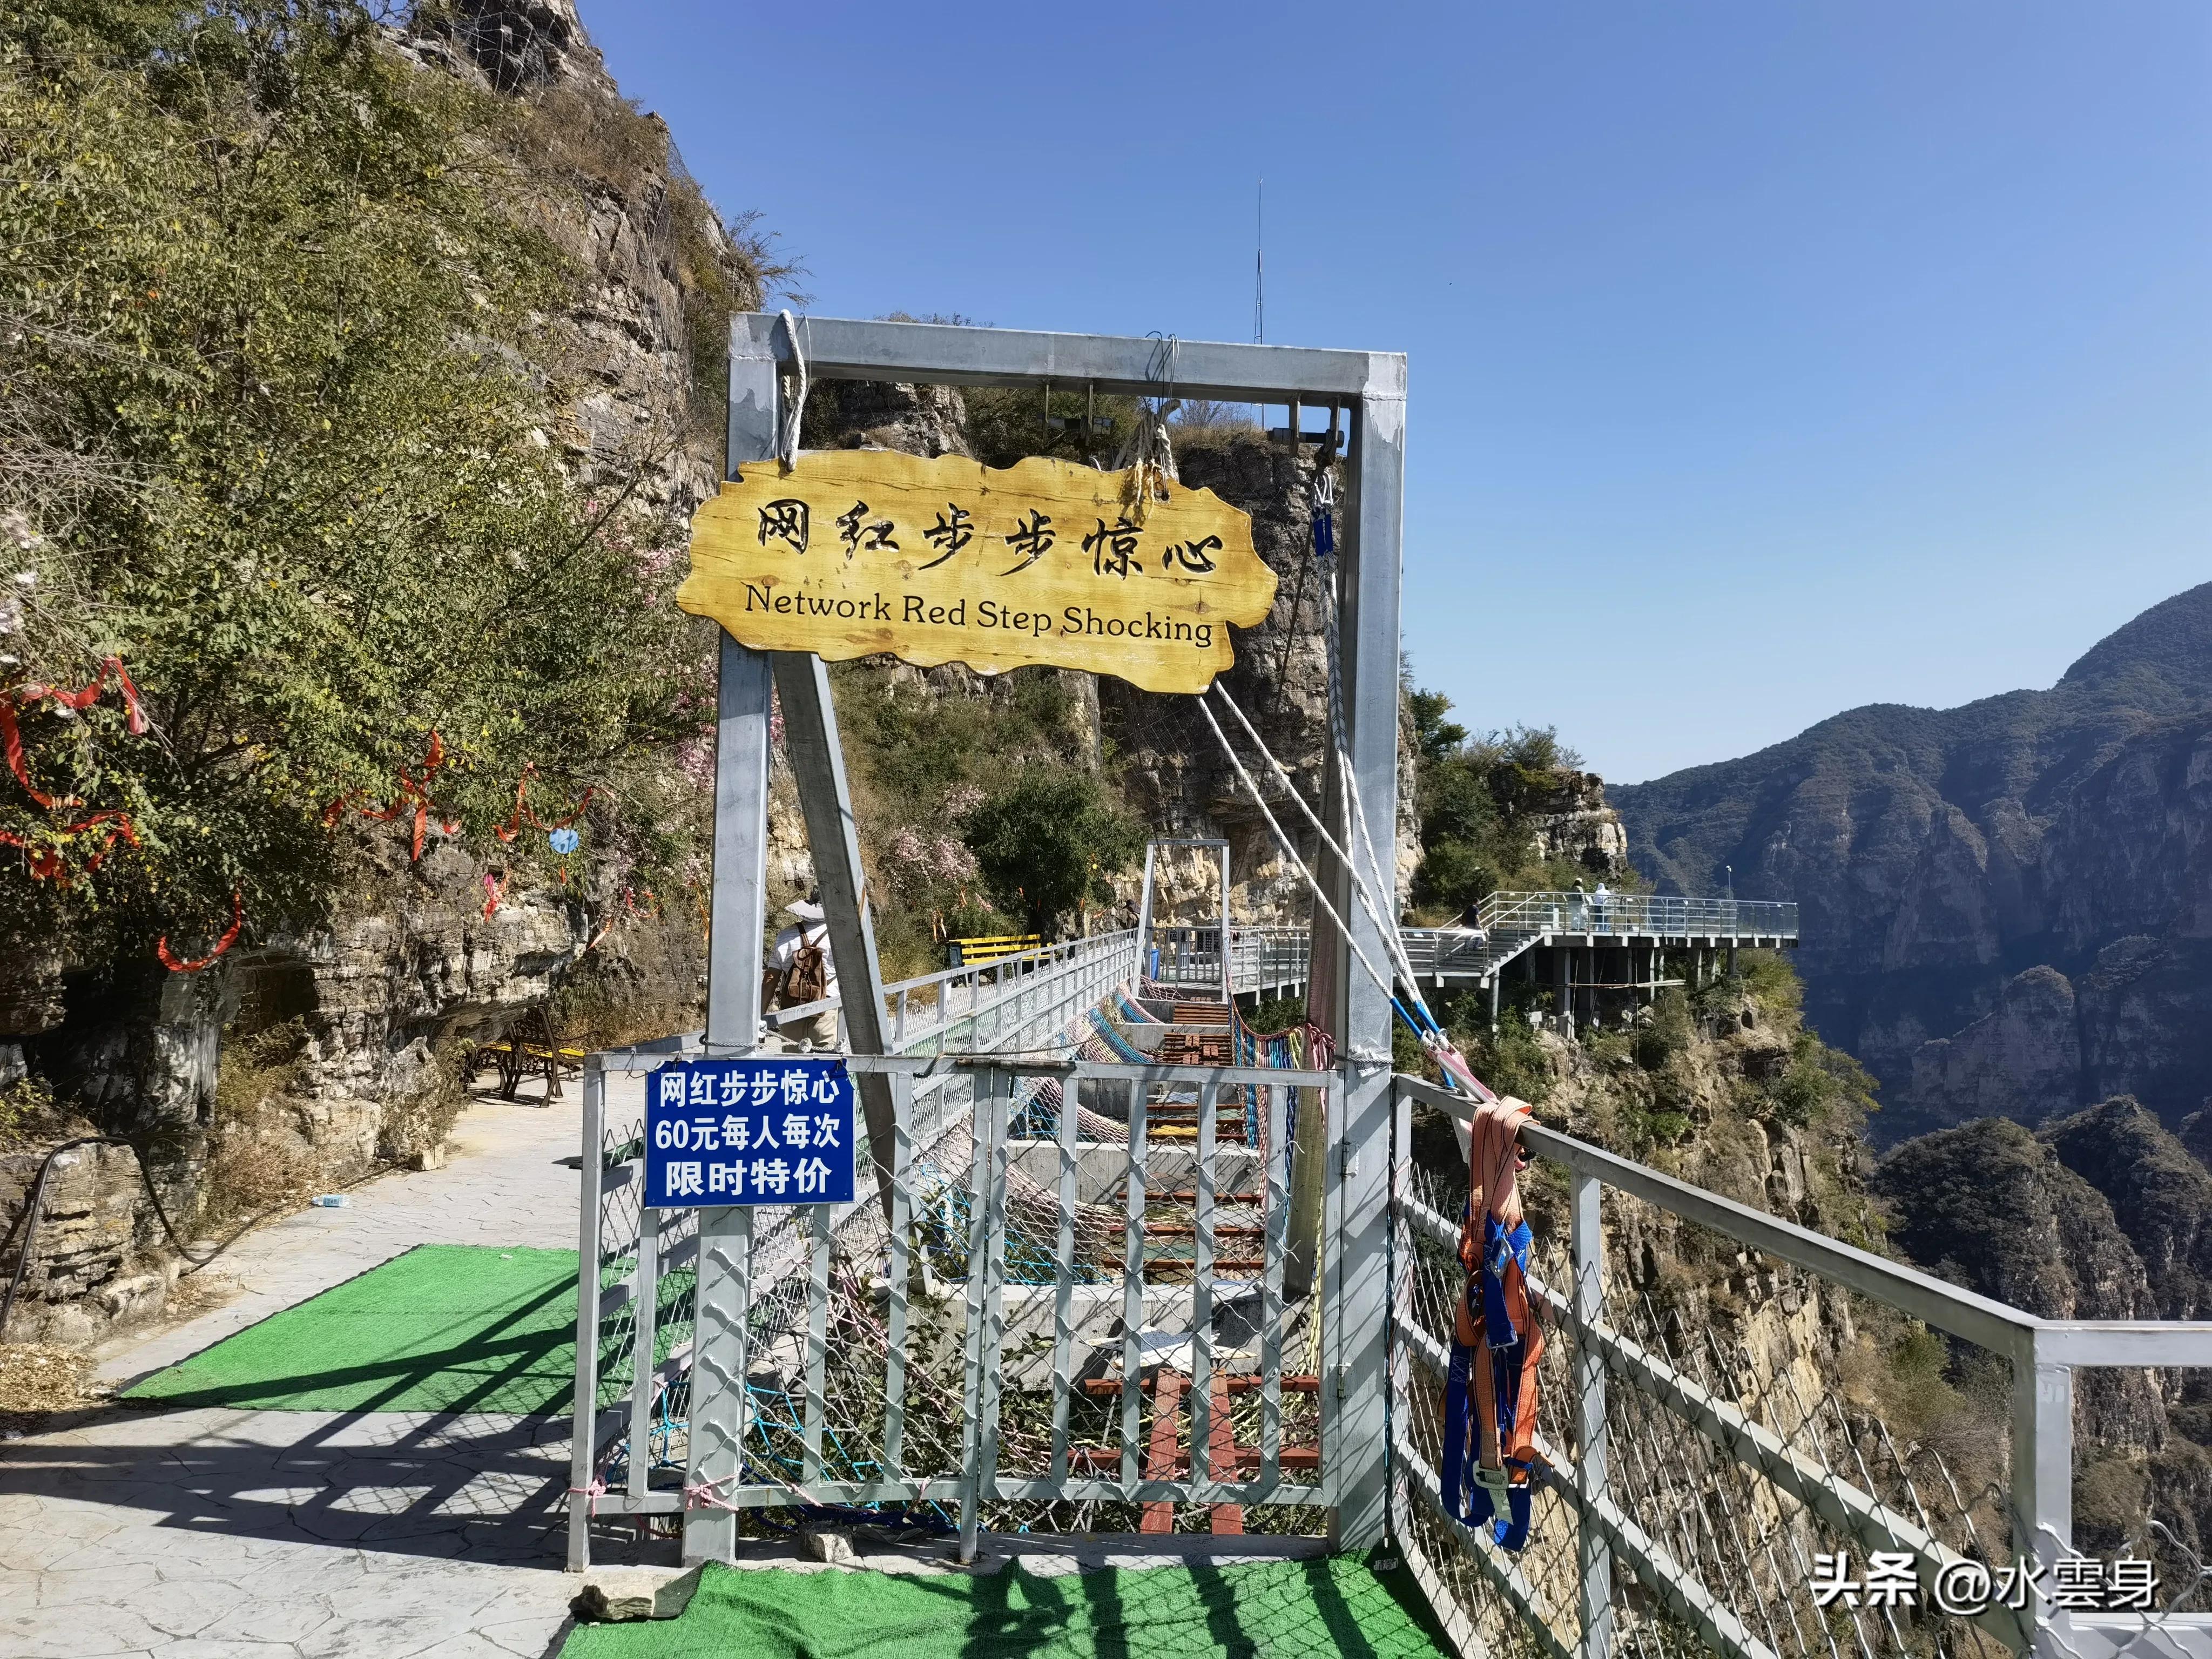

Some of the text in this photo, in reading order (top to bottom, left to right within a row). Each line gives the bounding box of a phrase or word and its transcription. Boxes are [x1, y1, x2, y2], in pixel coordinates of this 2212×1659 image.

[758, 498, 1223, 577] 网红步步惊心
[745, 584, 1213, 649] Network Red Step Shocking
[660, 1069, 840, 1108] 网红步步惊心
[655, 1113, 841, 1152] 60元每人每次
[666, 1157, 833, 1197] 限时特价
